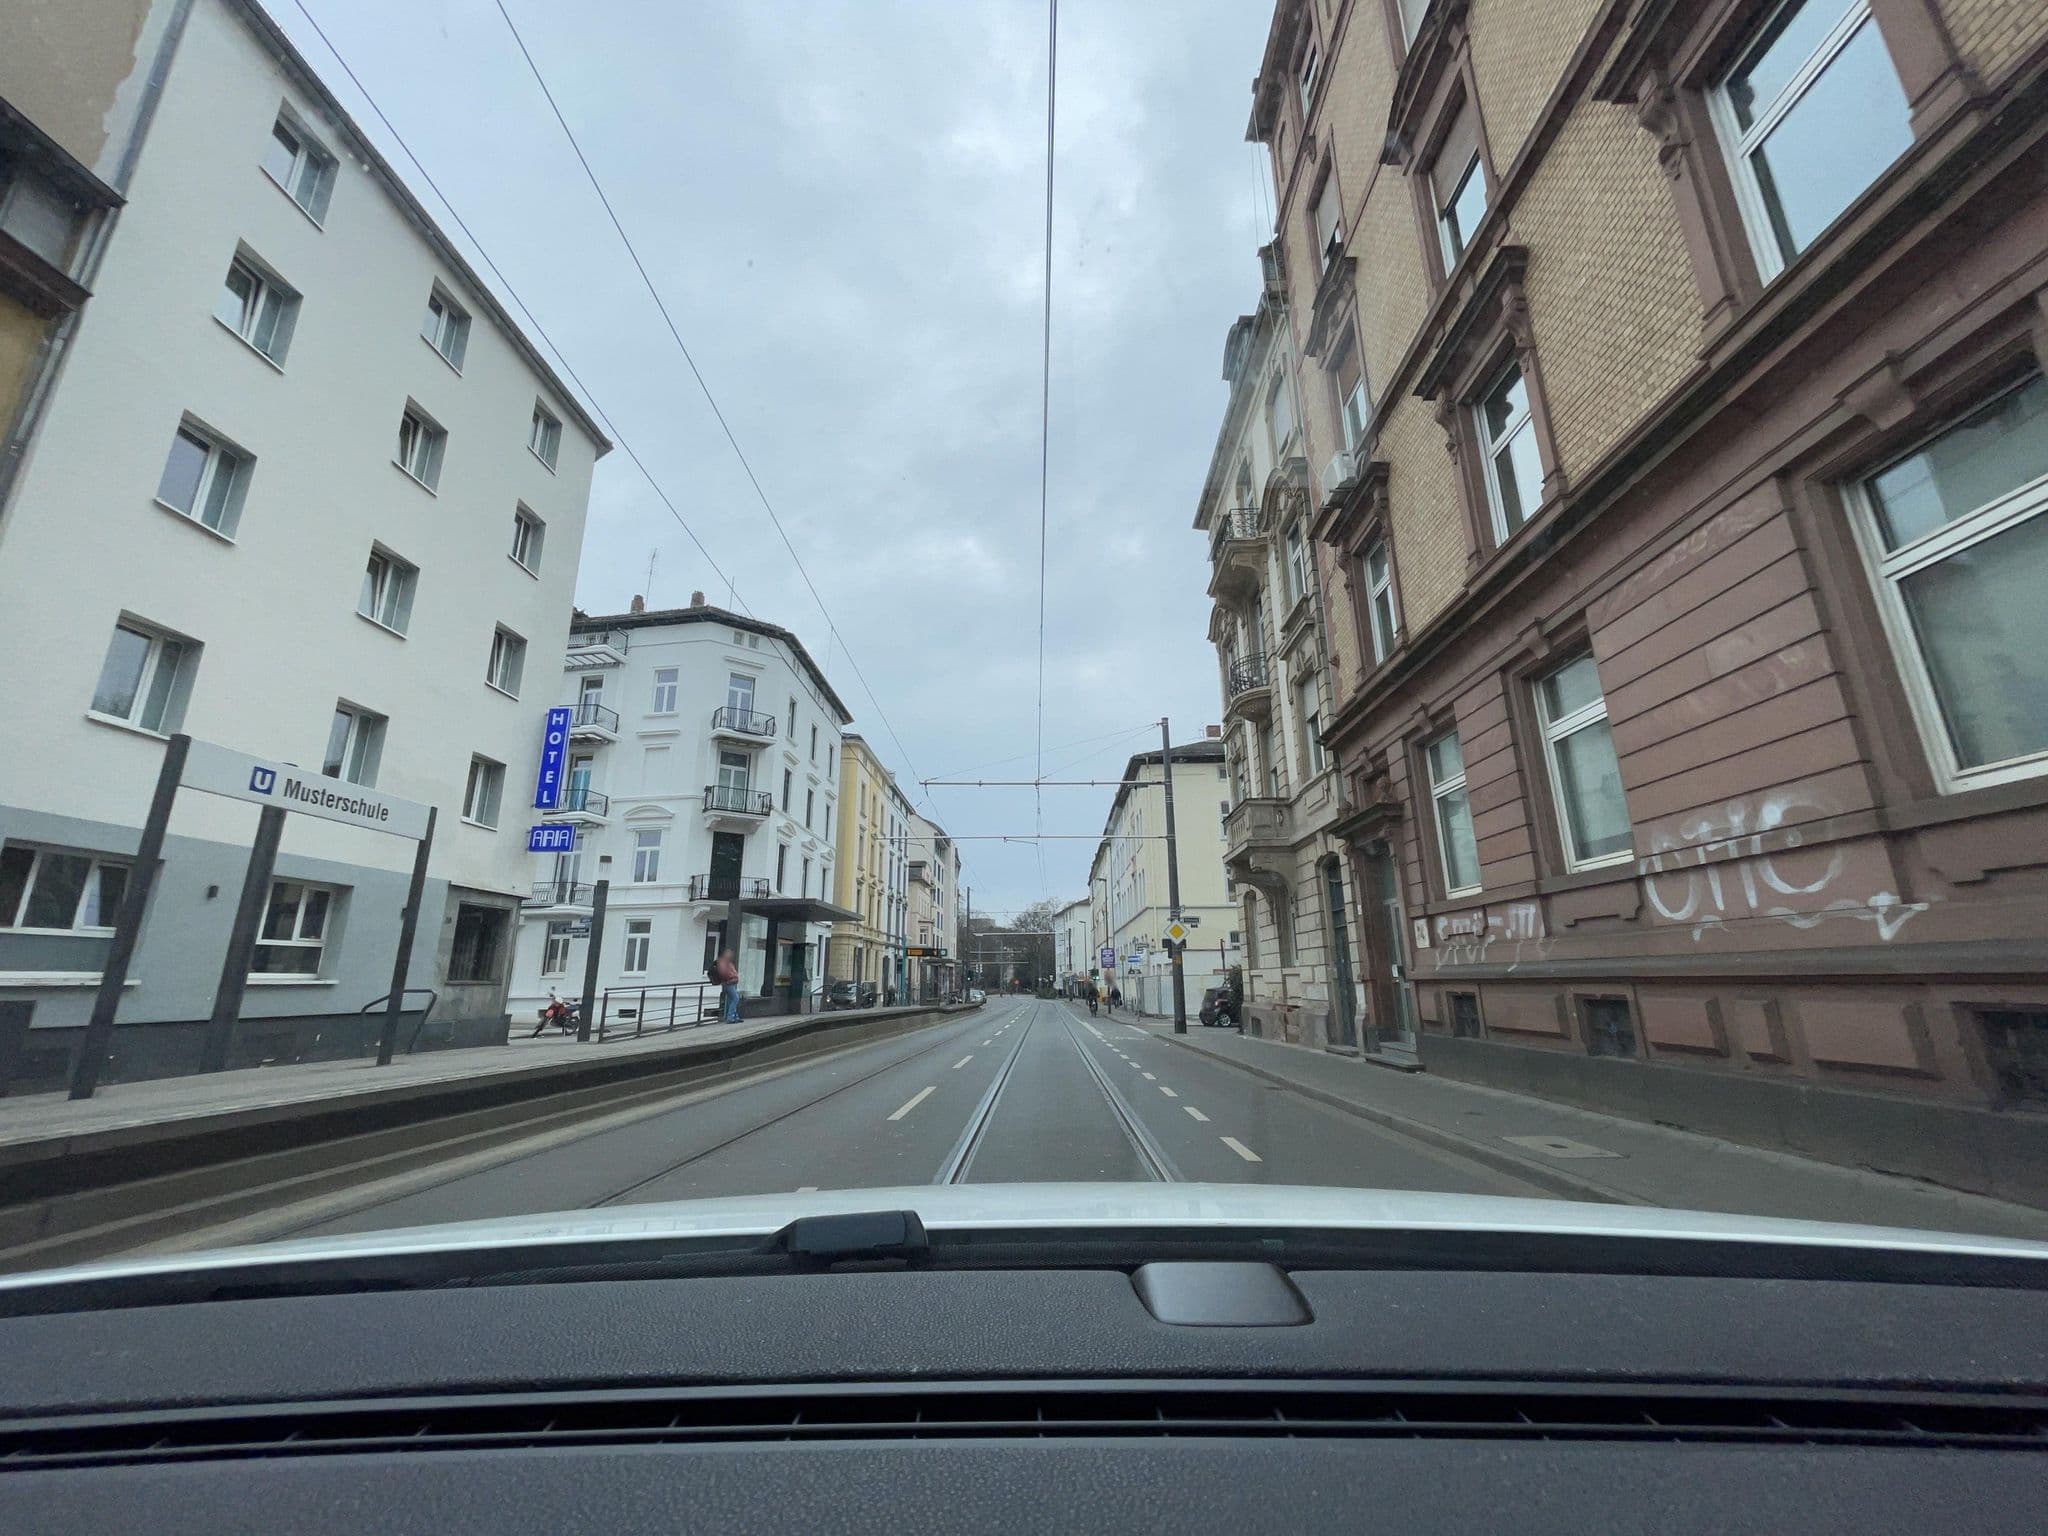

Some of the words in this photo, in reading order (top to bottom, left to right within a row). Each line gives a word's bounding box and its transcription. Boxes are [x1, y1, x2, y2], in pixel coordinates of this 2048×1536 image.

[542, 713, 564, 804] HOTEL
[252, 771, 273, 790] U
[283, 778, 389, 822] Musterschule
[532, 830, 570, 848] ARIA
